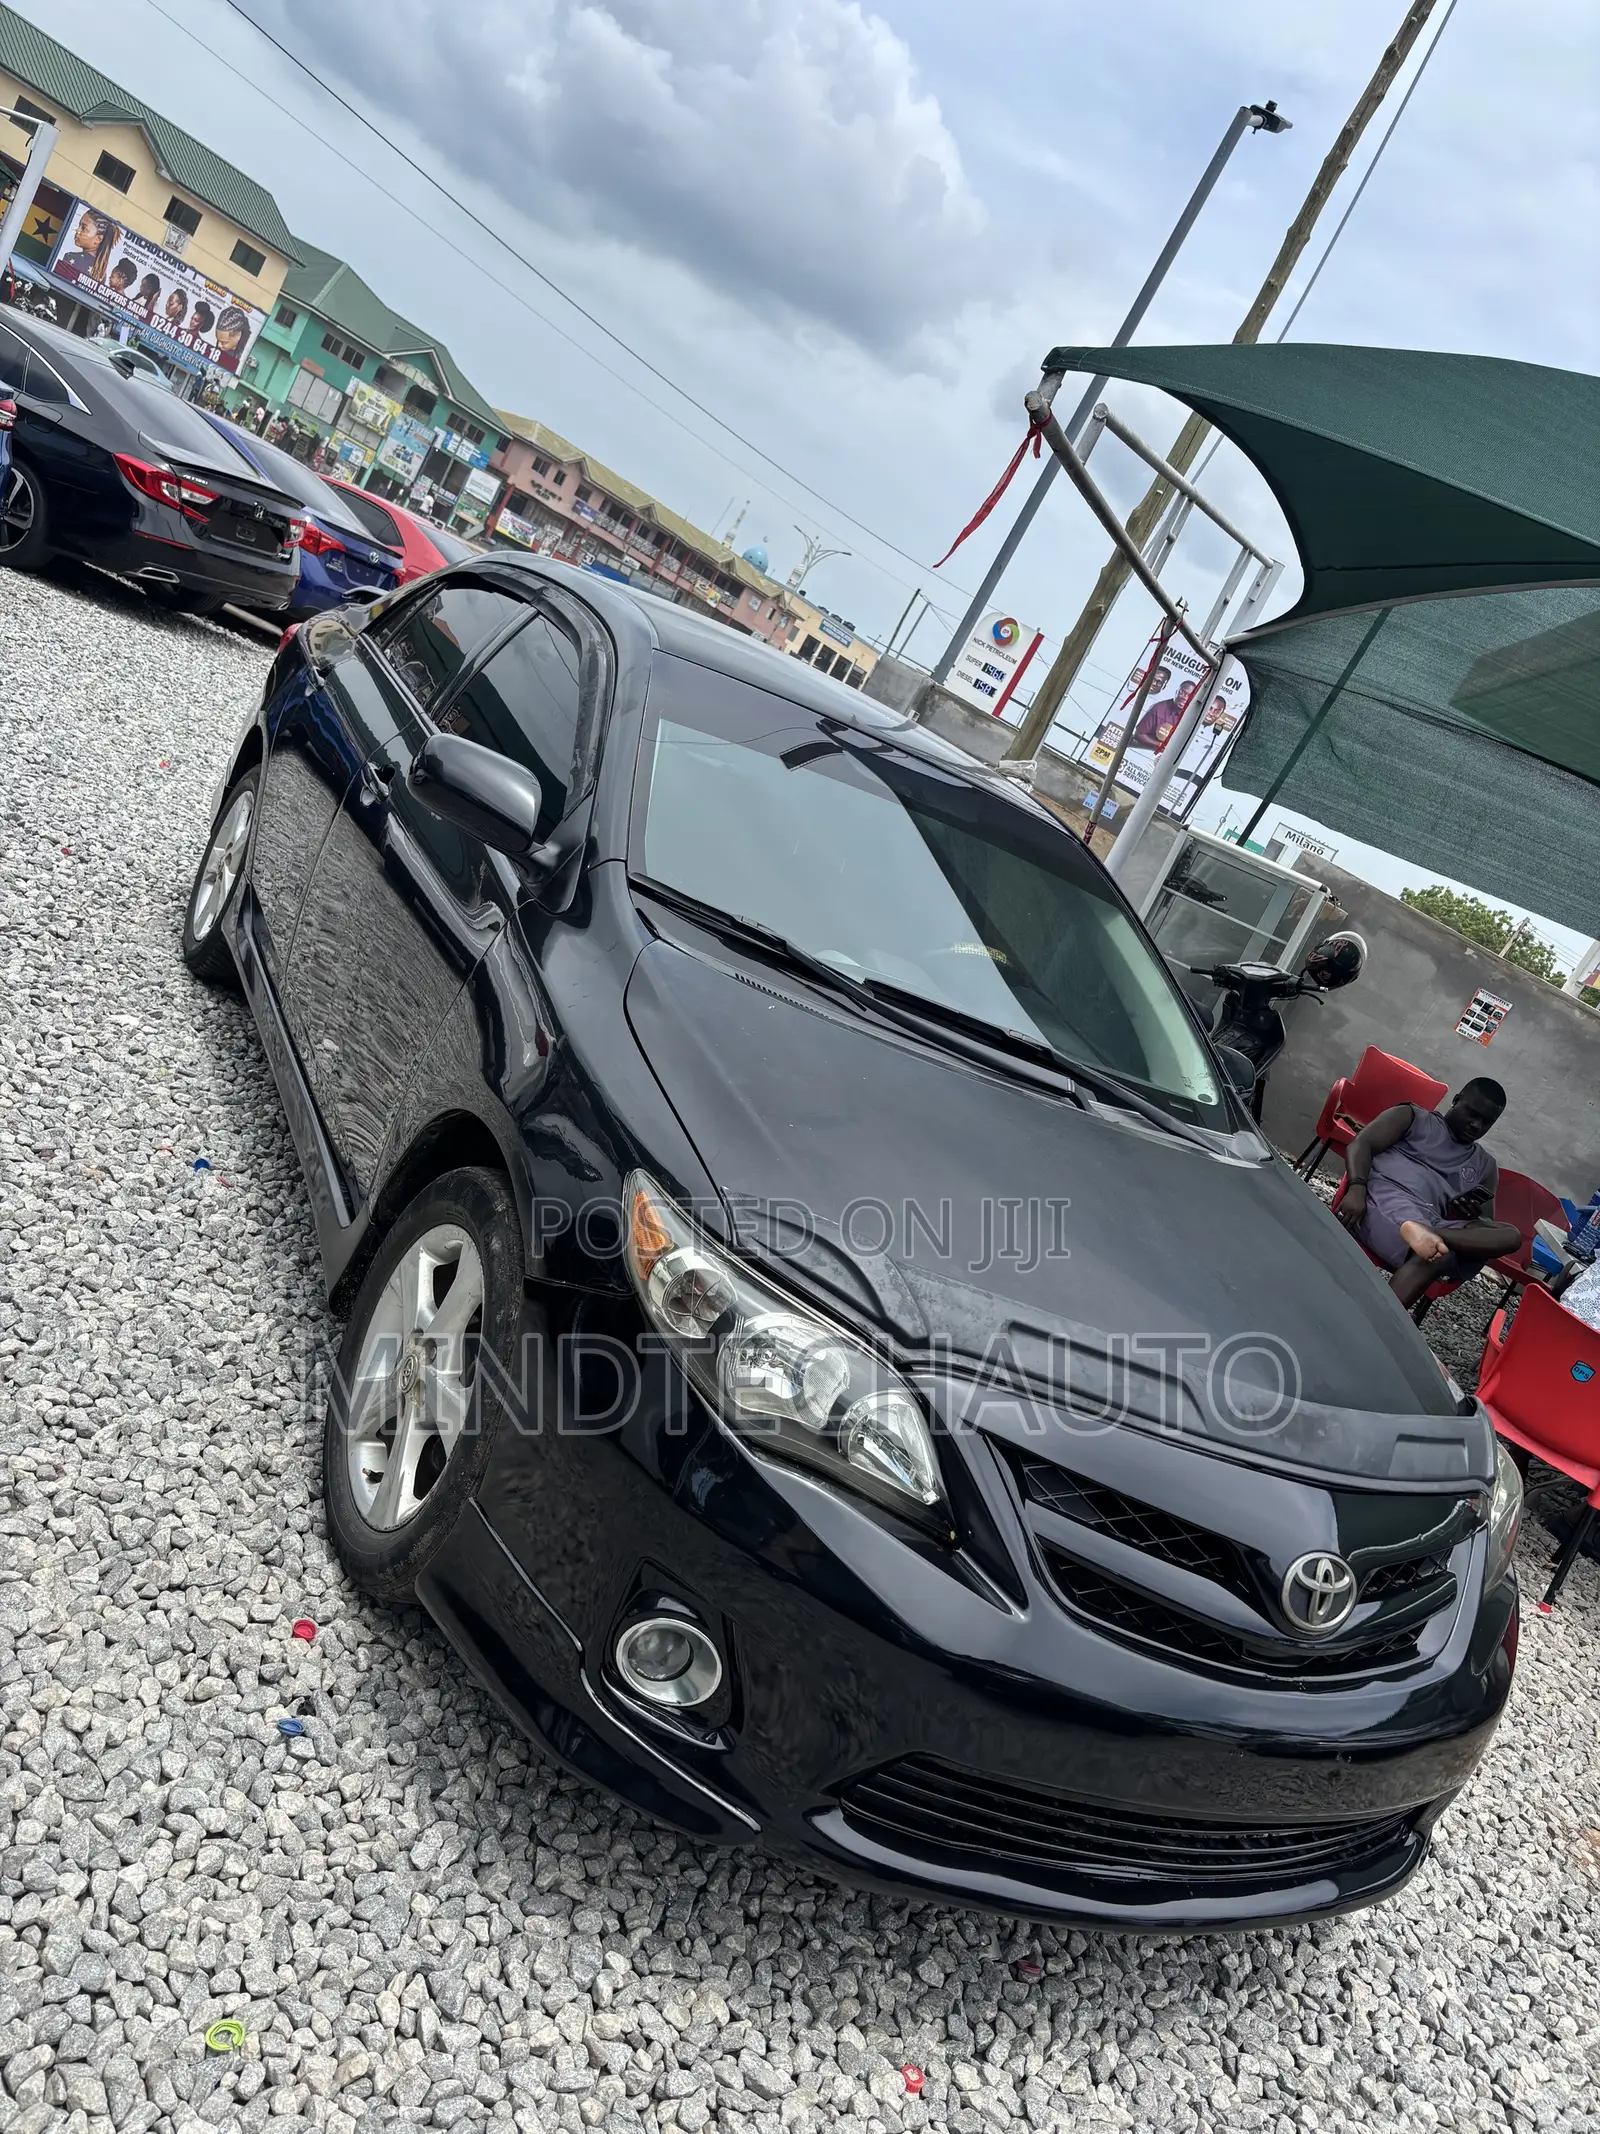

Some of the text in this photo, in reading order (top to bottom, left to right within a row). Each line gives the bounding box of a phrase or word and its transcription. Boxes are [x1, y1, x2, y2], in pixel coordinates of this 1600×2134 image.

[202, 279, 254, 314] PROMO PROMO
[75, 272, 99, 290] MULTI
[96, 283, 129, 307] CLIPPERS
[125, 299, 150, 319] SALON
[147, 313, 179, 339] 0244
[176, 329, 195, 347] 30
[190, 337, 209, 355] 64
[206, 345, 223, 363] 18
[148, 331, 183, 358] DIAGNOSTIC
[964, 653, 983, 668] SUPER
[971, 635, 1018, 665] NICK PETROLEUM
[955, 669, 975, 684] DIESEL
[1162, 655, 1171, 663] OF
[1170, 659, 1184, 670] NEW
[1182, 666, 1204, 681] CHURC
[1103, 729, 1122, 743] JUNE
[1106, 723, 1125, 737] 14TH
[1094, 745, 1111, 759] 2PM
[1124, 765, 1150, 782] ALL NIG
[1283, 829, 1326, 857] Milano
